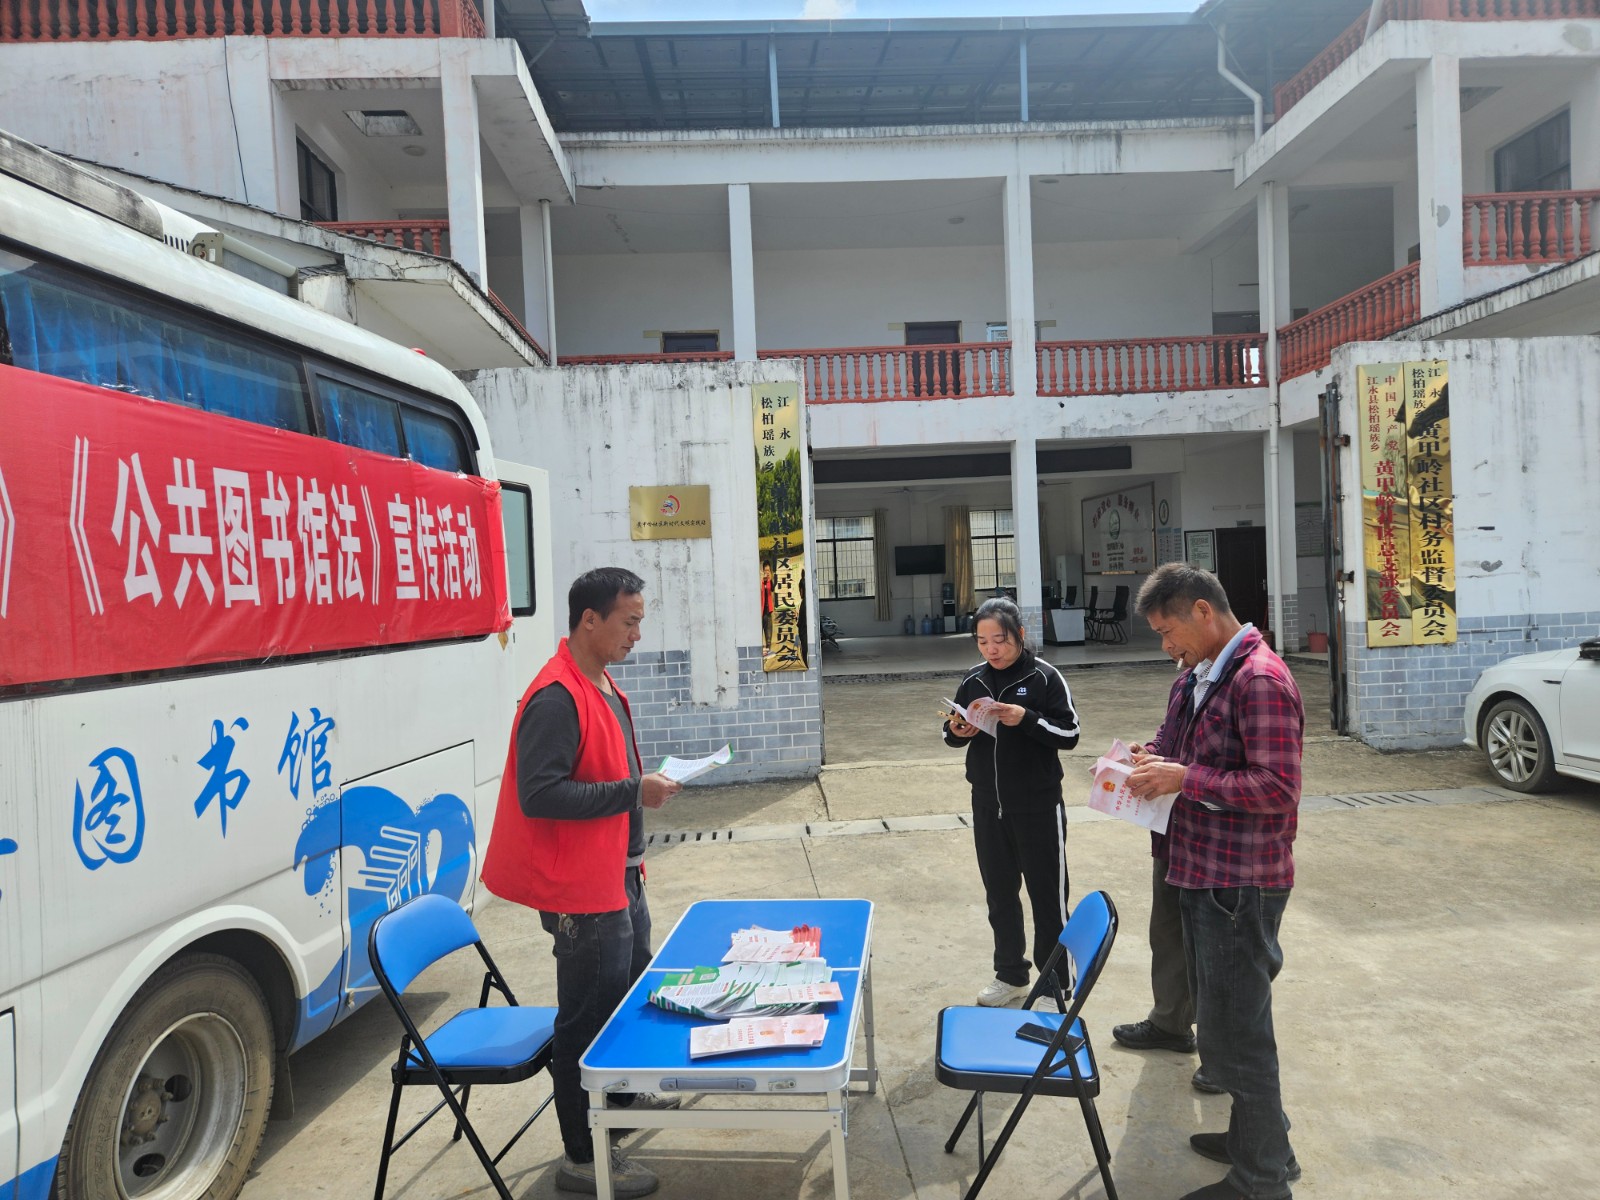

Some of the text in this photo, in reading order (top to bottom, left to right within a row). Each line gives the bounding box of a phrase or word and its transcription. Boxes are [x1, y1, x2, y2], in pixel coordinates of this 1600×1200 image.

[760, 396, 775, 474] 松柏瑶族乡
[776, 395, 793, 473] 江永县
[1366, 375, 1380, 452] 江永县松柏瑶族乡
[1384, 375, 1399, 452] 中国共产党
[1375, 460, 1402, 638] 黄甲岭社区总支部委员会
[1416, 423, 1448, 638] 黄甲岭社区村务监督委员会
[0, 707, 337, 872] 图书馆
